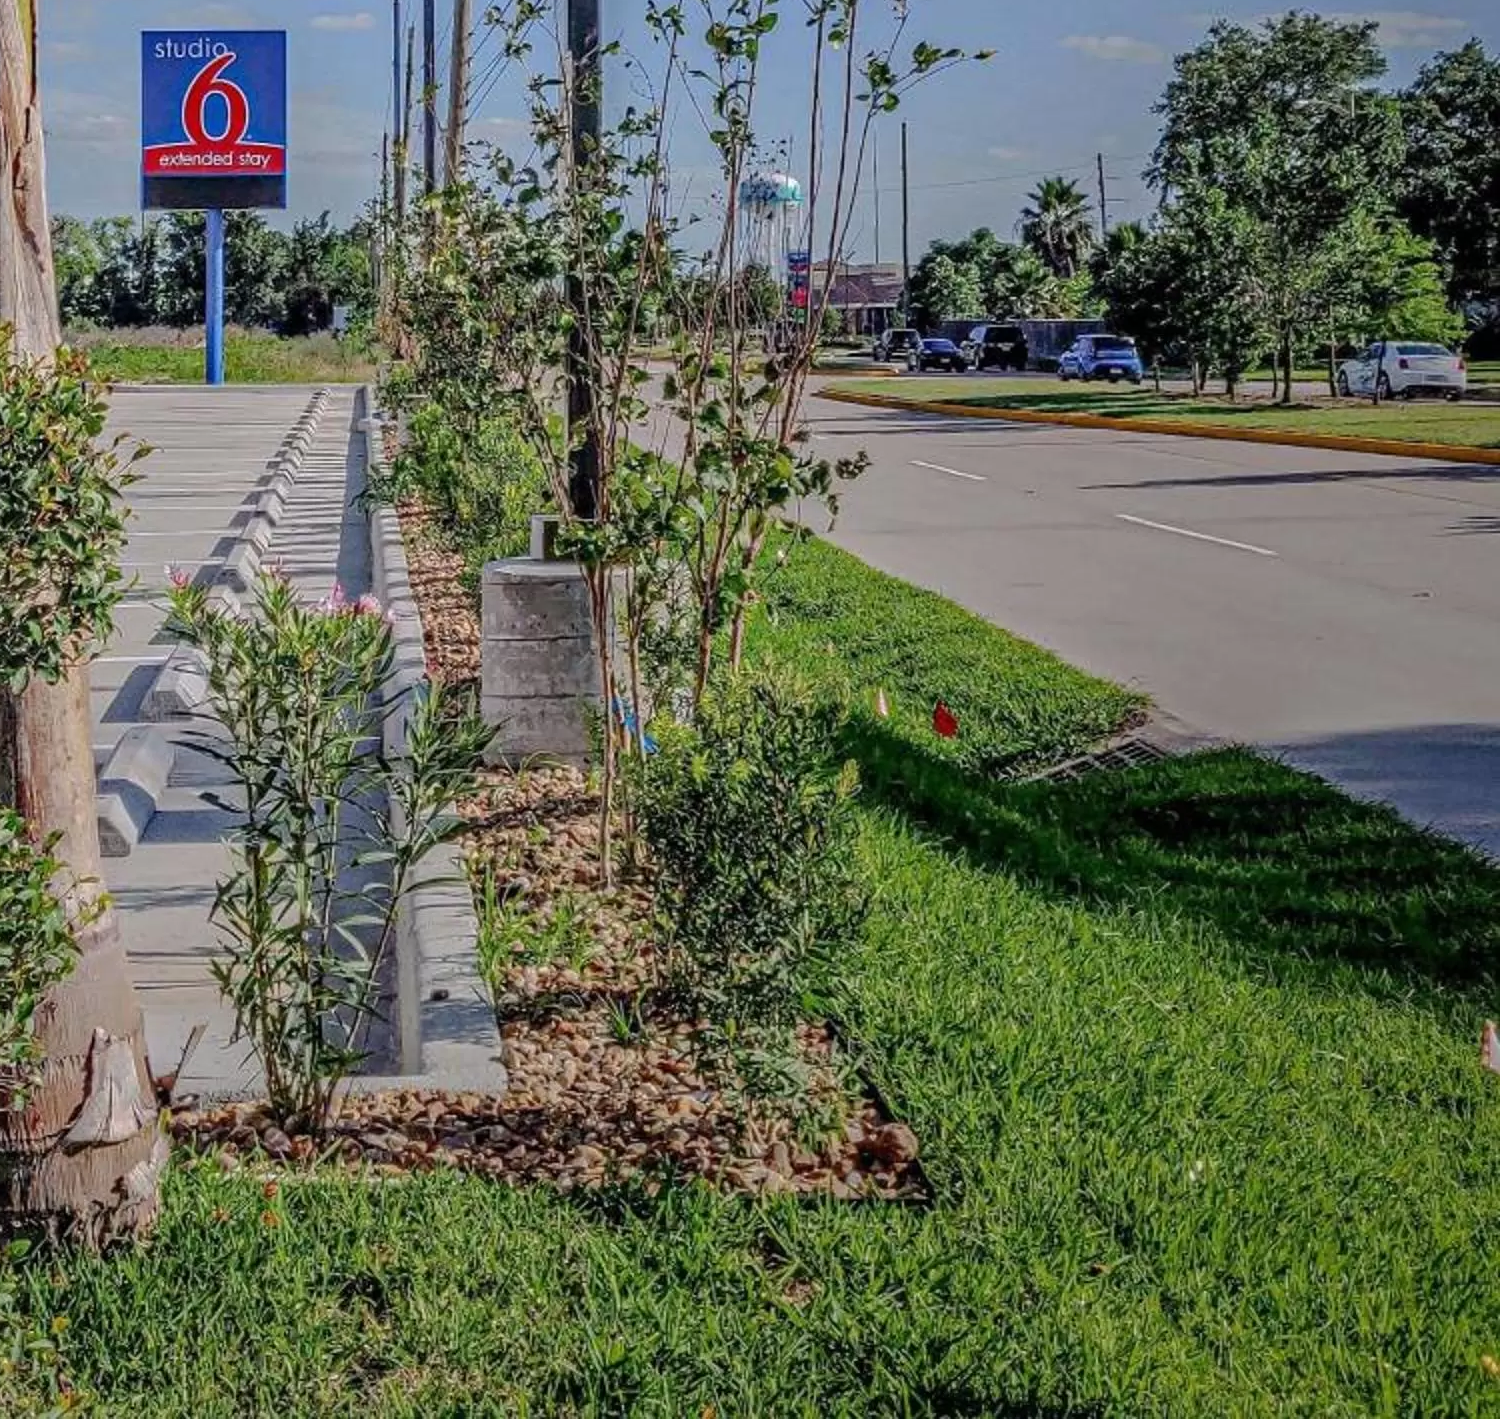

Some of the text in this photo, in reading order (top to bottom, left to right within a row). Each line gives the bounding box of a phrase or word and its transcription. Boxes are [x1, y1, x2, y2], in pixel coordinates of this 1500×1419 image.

[155, 37, 228, 58] studio
[182, 52, 249, 143] 6
[159, 151, 271, 168] extended stay
